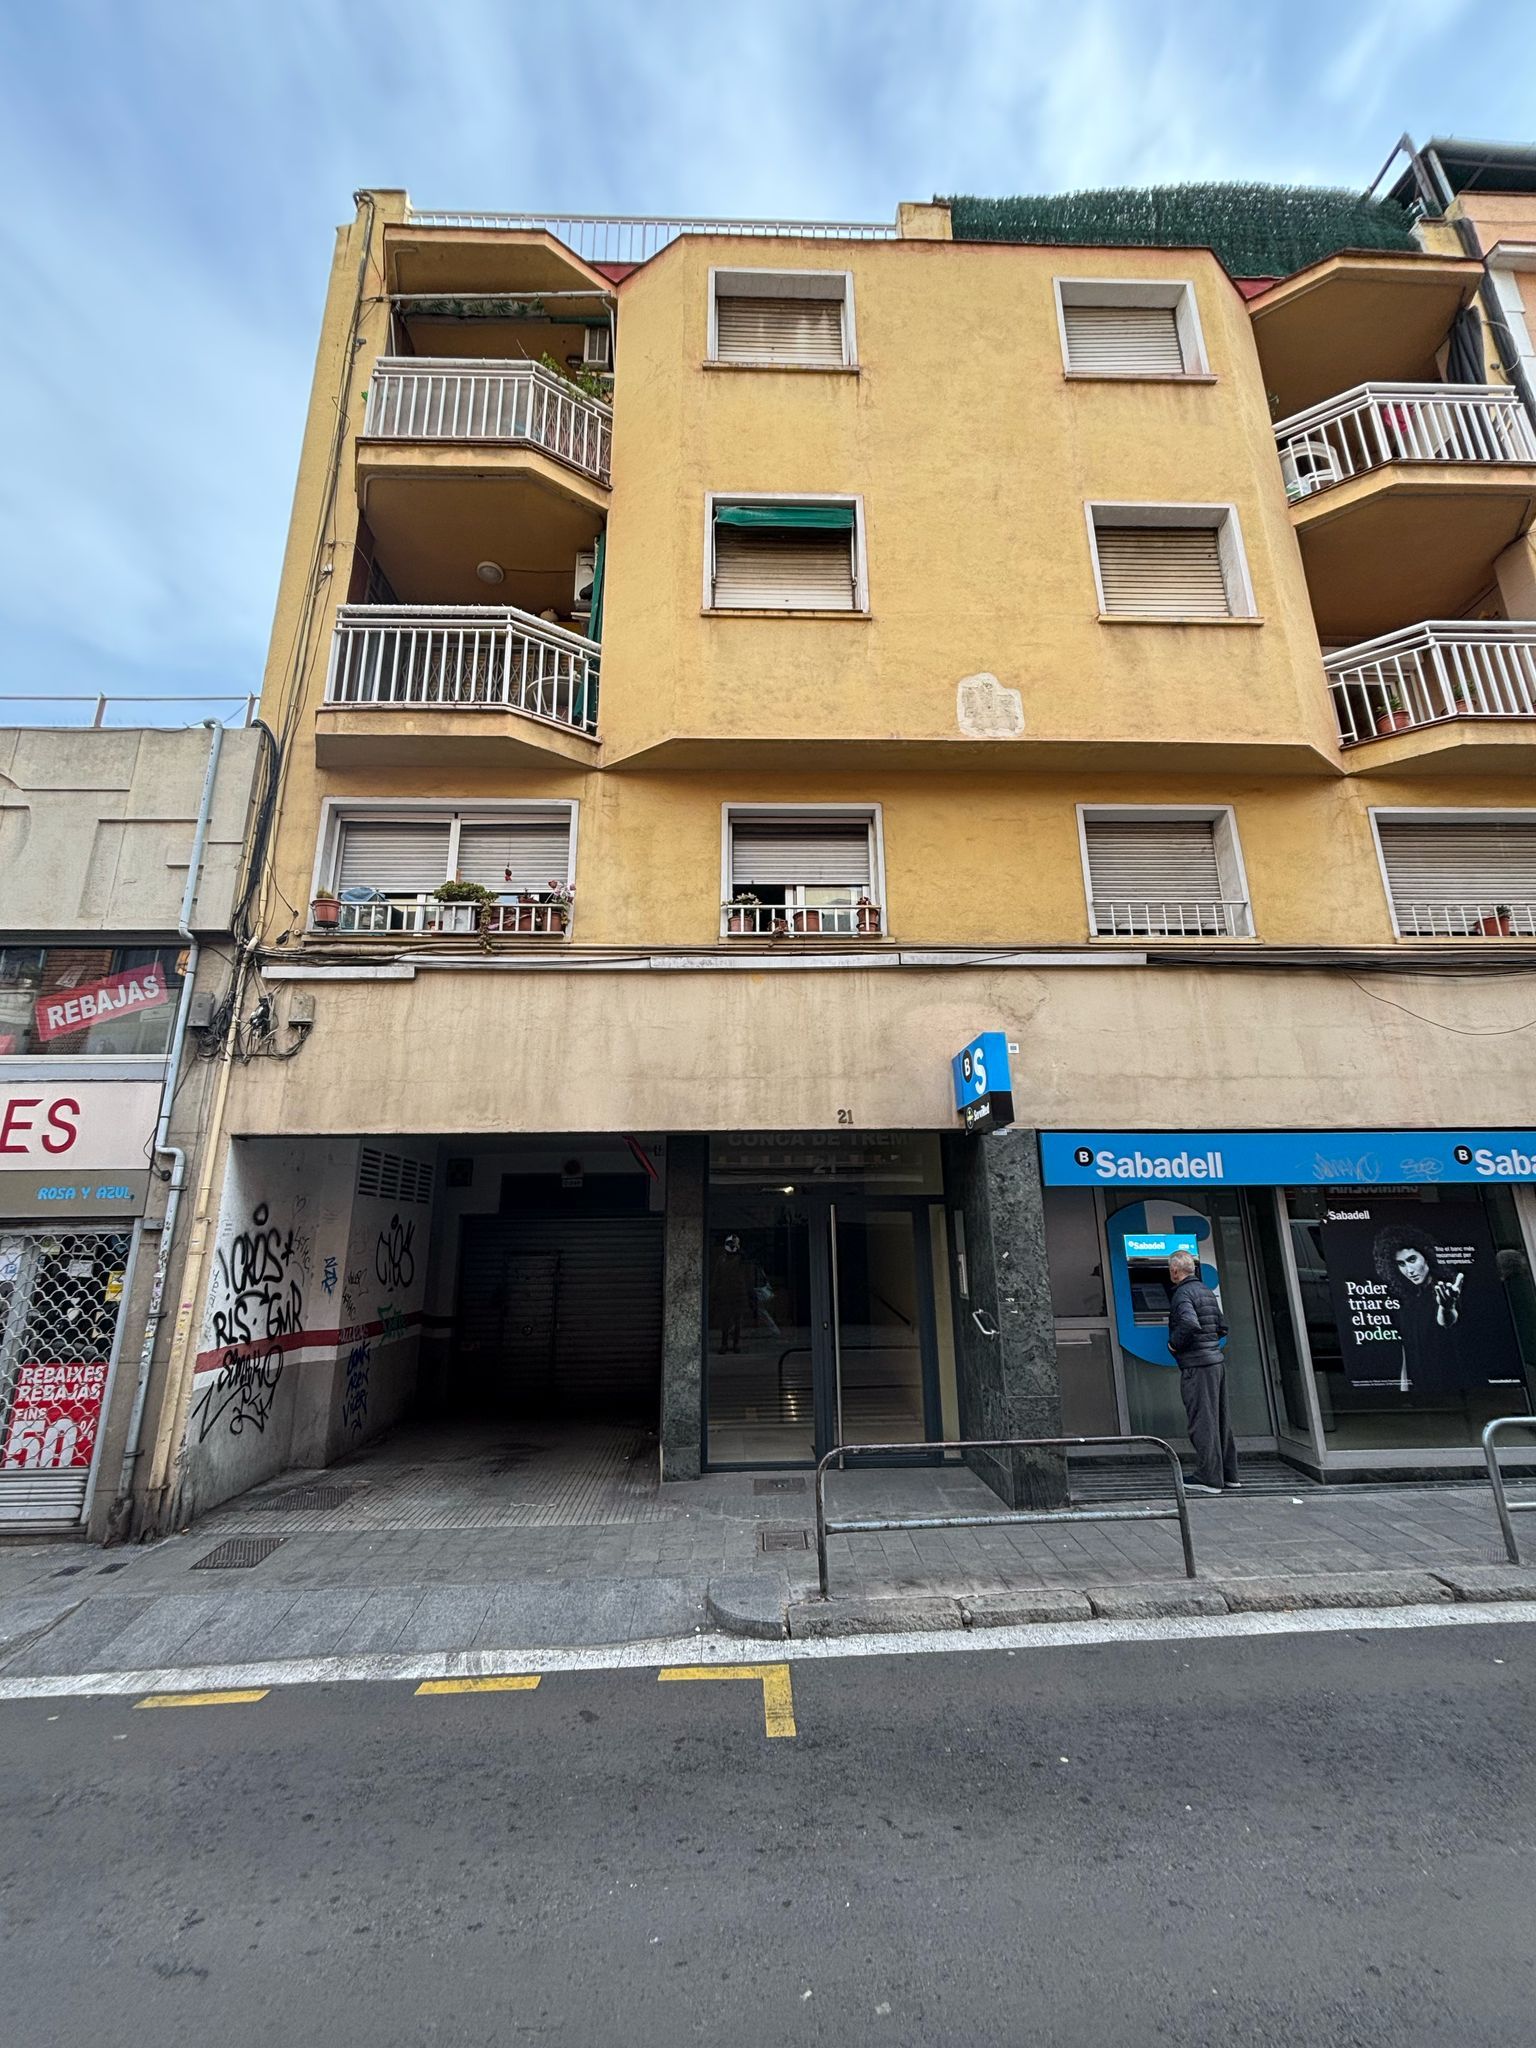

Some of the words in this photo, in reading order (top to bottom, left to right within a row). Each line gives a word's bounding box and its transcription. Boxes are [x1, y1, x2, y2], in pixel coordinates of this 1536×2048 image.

[47, 975, 161, 1030] REBAJAS
[963, 1057, 971, 1077] B
[837, 1109, 854, 1124] 21
[0, 1098, 80, 1154] ES
[849, 1132, 911, 1145] TREM
[1458, 1149, 1469, 1161] B
[1079, 1151, 1089, 1163] B
[1095, 1150, 1225, 1179] Sabadell
[37, 1186, 76, 1200] ROSA
[81, 1186, 90, 1200] Y
[1328, 1209, 1371, 1220] Sabadell
[1345, 1280, 1388, 1296] Poder
[1349, 1297, 1383, 1311] triar
[1384, 1296, 1401, 1310] és
[1352, 1313, 1365, 1326] el
[1367, 1313, 1392, 1326] teu
[1354, 1326, 1402, 1345] poder.
[21, 1365, 105, 1384] REBAIXES
[18, 1383, 101, 1402] REBAJAS
[15, 1408, 47, 1421] FINS
